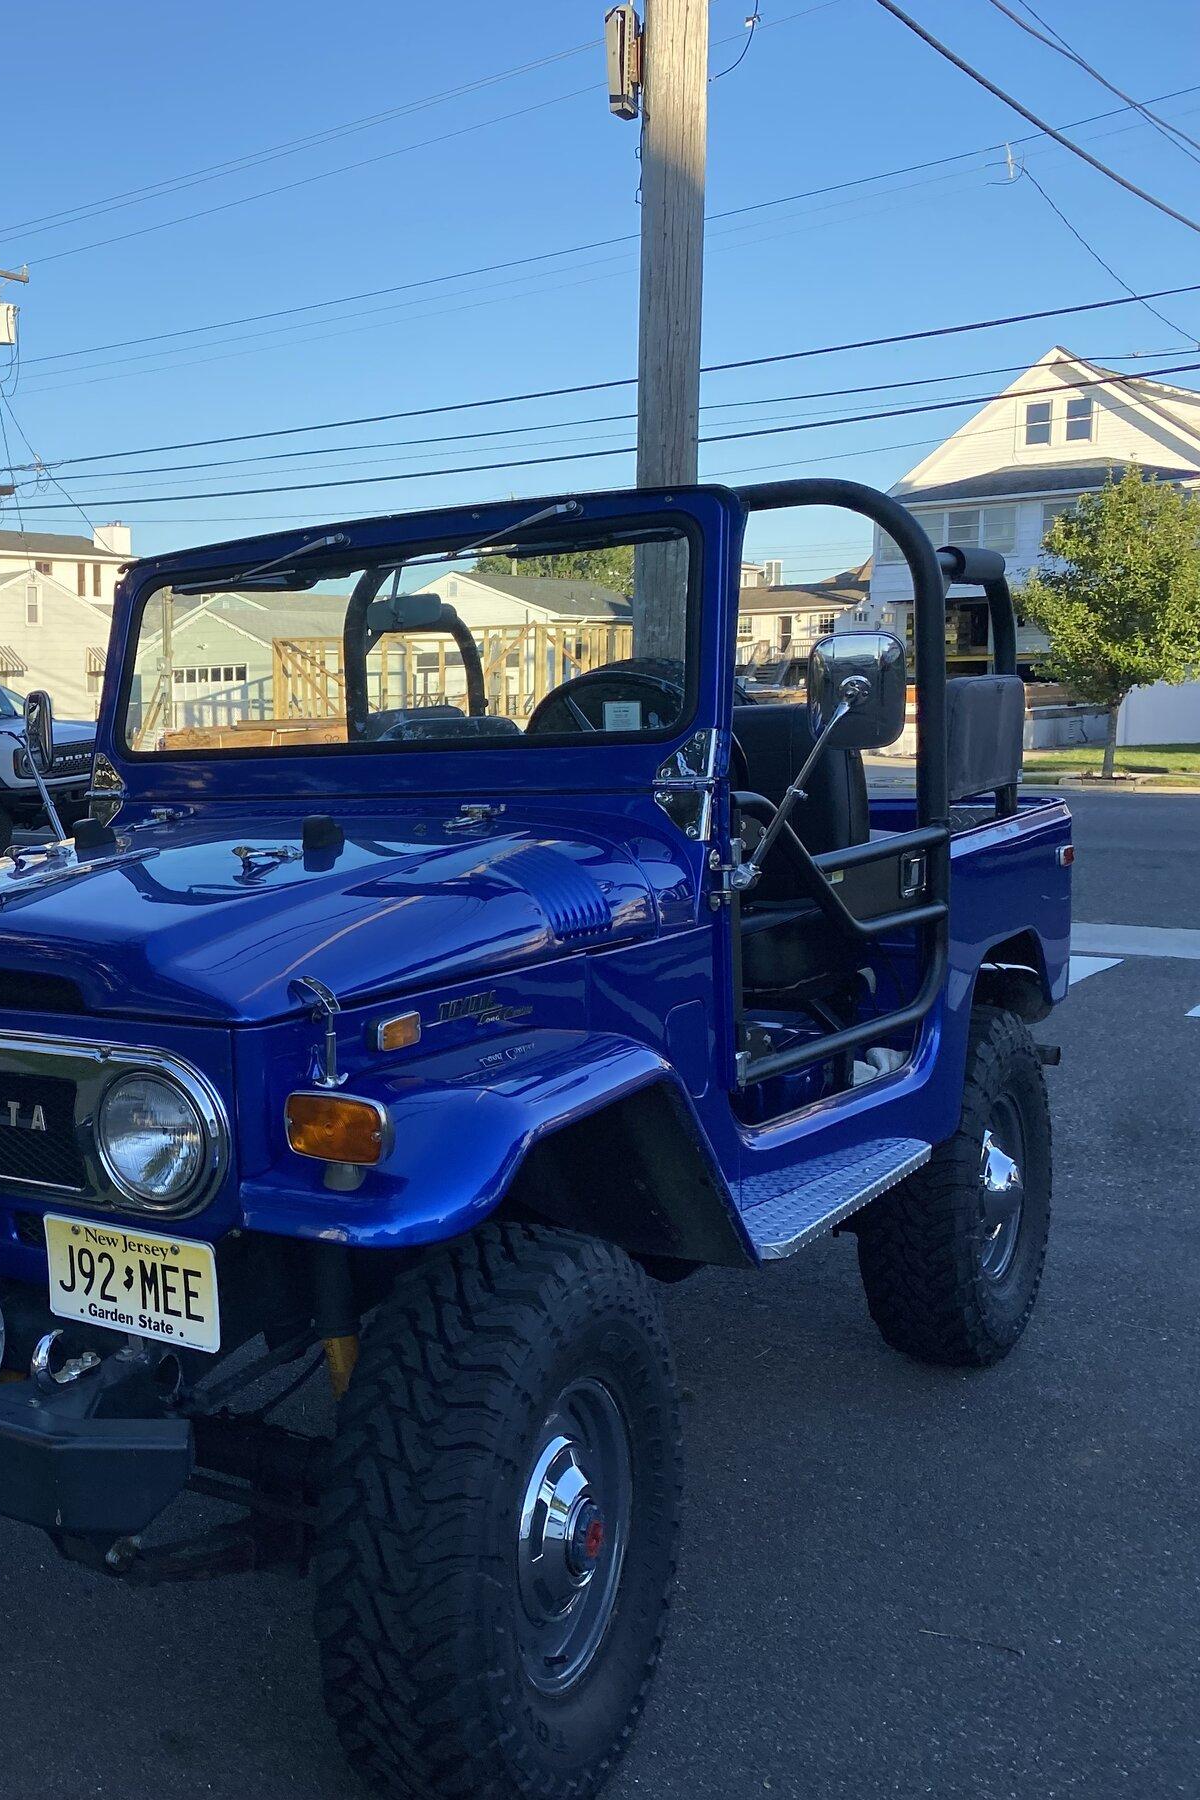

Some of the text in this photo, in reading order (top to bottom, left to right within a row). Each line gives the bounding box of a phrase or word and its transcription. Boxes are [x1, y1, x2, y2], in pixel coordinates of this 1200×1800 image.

[84, 1227, 169, 1261] New Jersey
[59, 1245, 205, 1323] J92 MEE
[88, 1303, 174, 1335] Garden State
